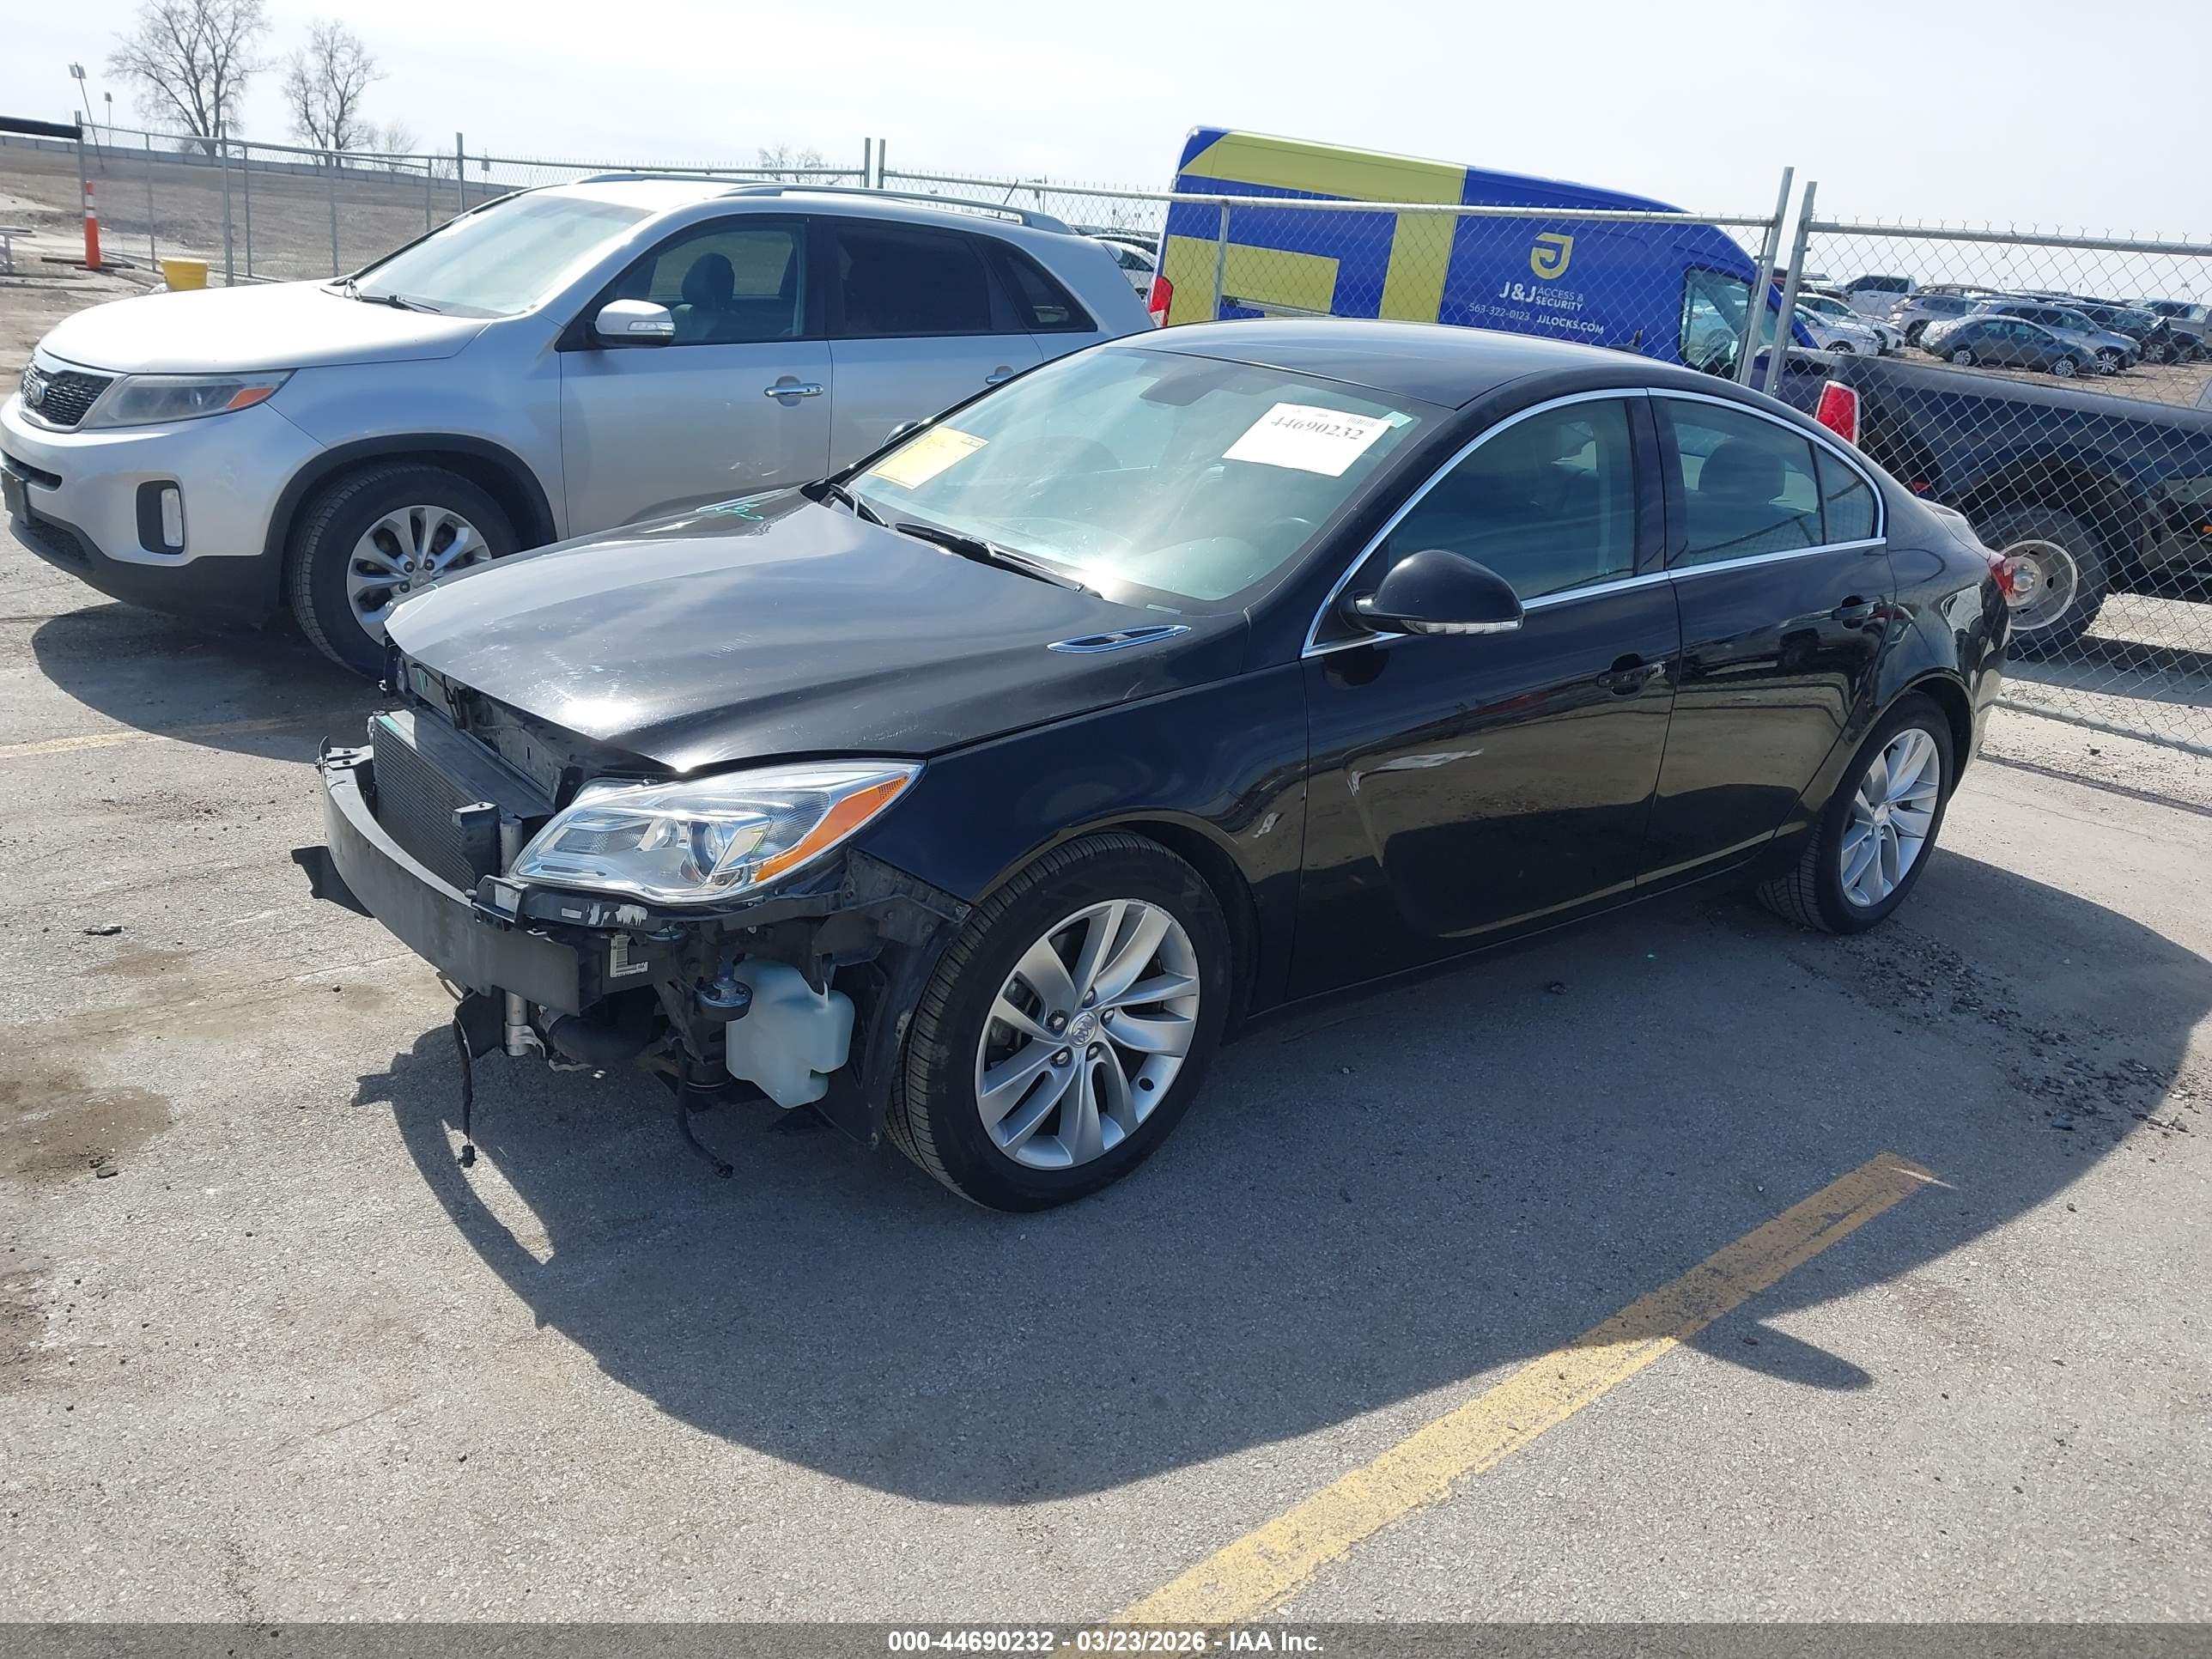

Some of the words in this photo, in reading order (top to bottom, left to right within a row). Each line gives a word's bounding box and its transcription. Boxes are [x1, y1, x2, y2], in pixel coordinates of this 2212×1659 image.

[1498, 281, 1537, 303] J&J
[1537, 286, 1575, 301] ACCESS
[1577, 293, 1583, 302] &
[1468, 302, 1530, 321] 563-322-0123
[1535, 295, 1583, 312] SECURITY
[1536, 314, 1604, 335] JJLOCKS.COM
[1271, 416, 1364, 440] 44690232
